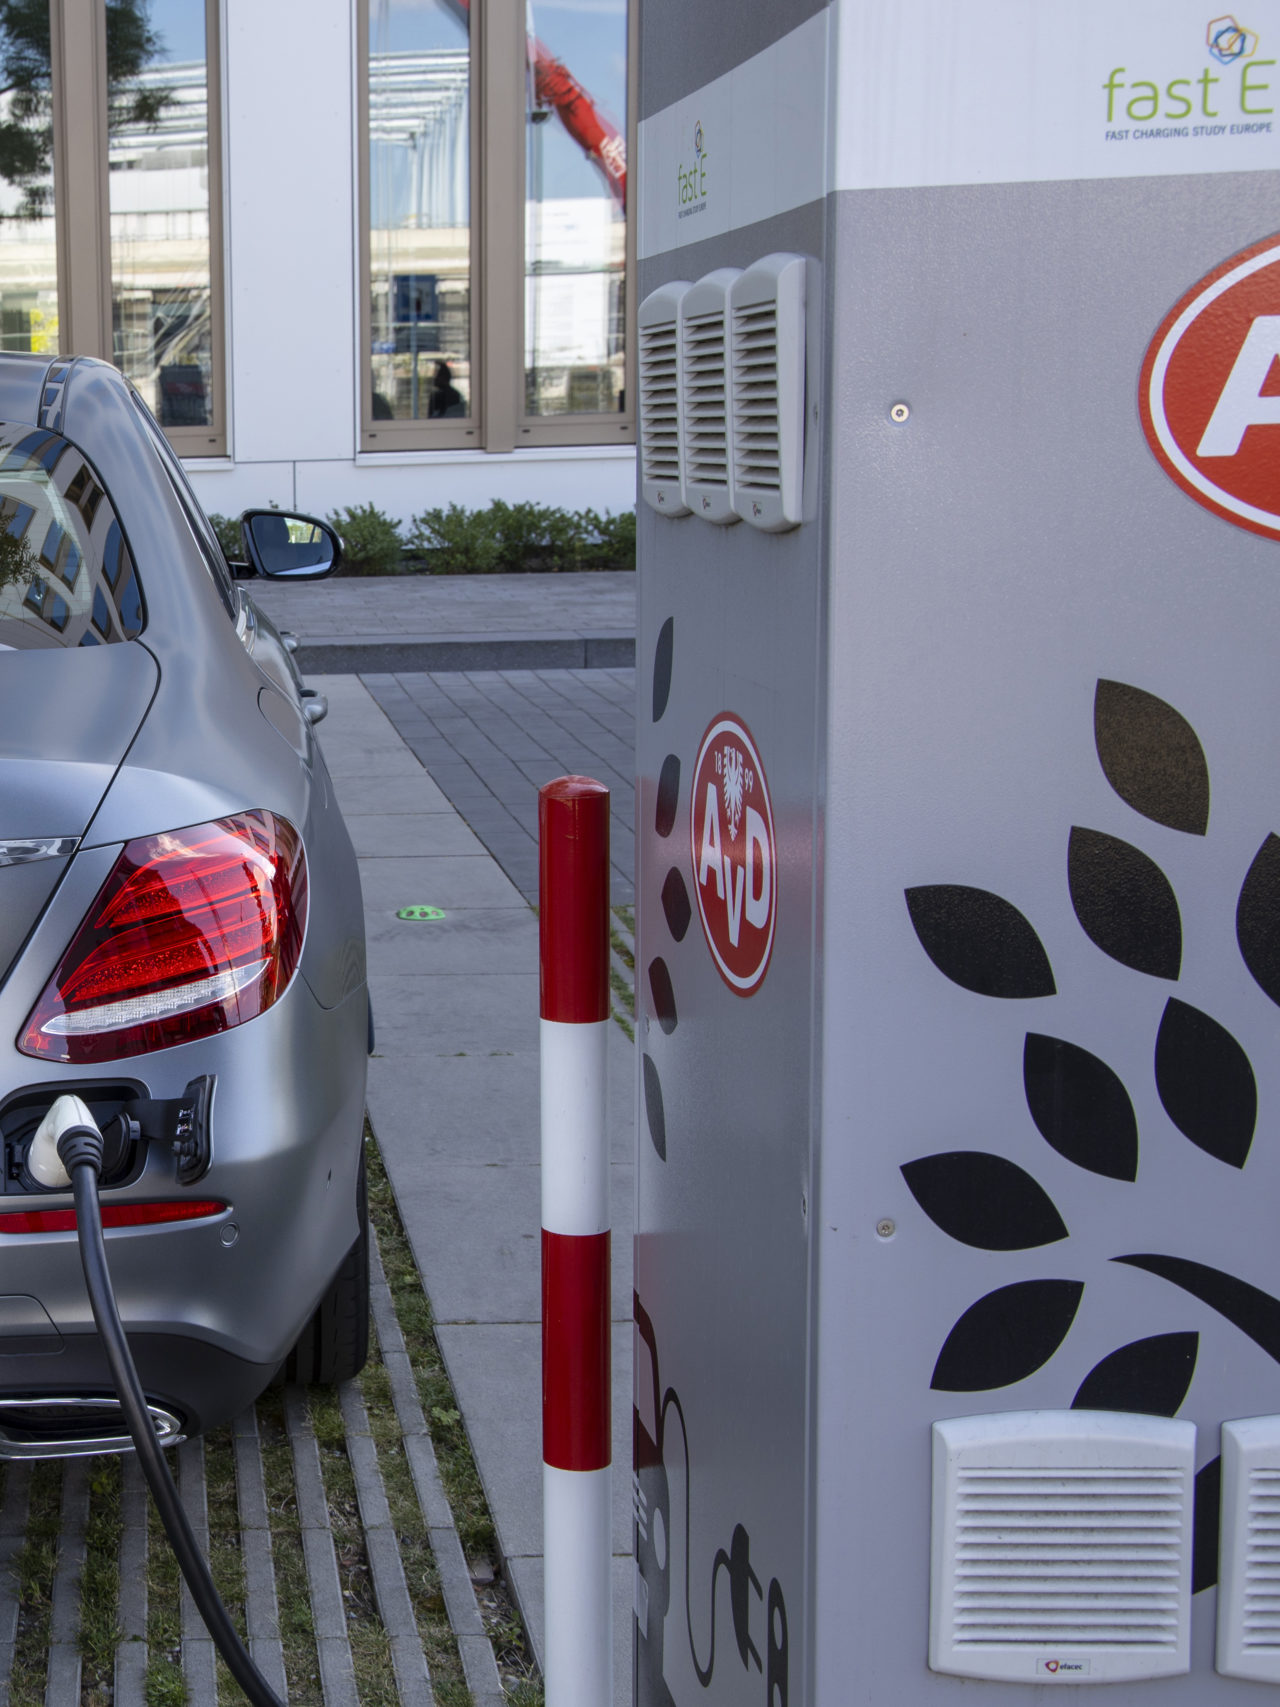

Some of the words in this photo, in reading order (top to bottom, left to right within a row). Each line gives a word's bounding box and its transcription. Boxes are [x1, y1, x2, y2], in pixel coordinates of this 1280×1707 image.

[1102, 67, 1220, 122] fast
[1240, 60, 1276, 115] E
[1105, 129, 1130, 141] FAST
[1133, 127, 1189, 140] CHARGING
[1192, 125, 1227, 136] STUDY
[1230, 122, 1273, 134] EUROPE
[678, 162, 698, 206] fast
[744, 766, 754, 793] 99
[1060, 1662, 1083, 1670] efacec
